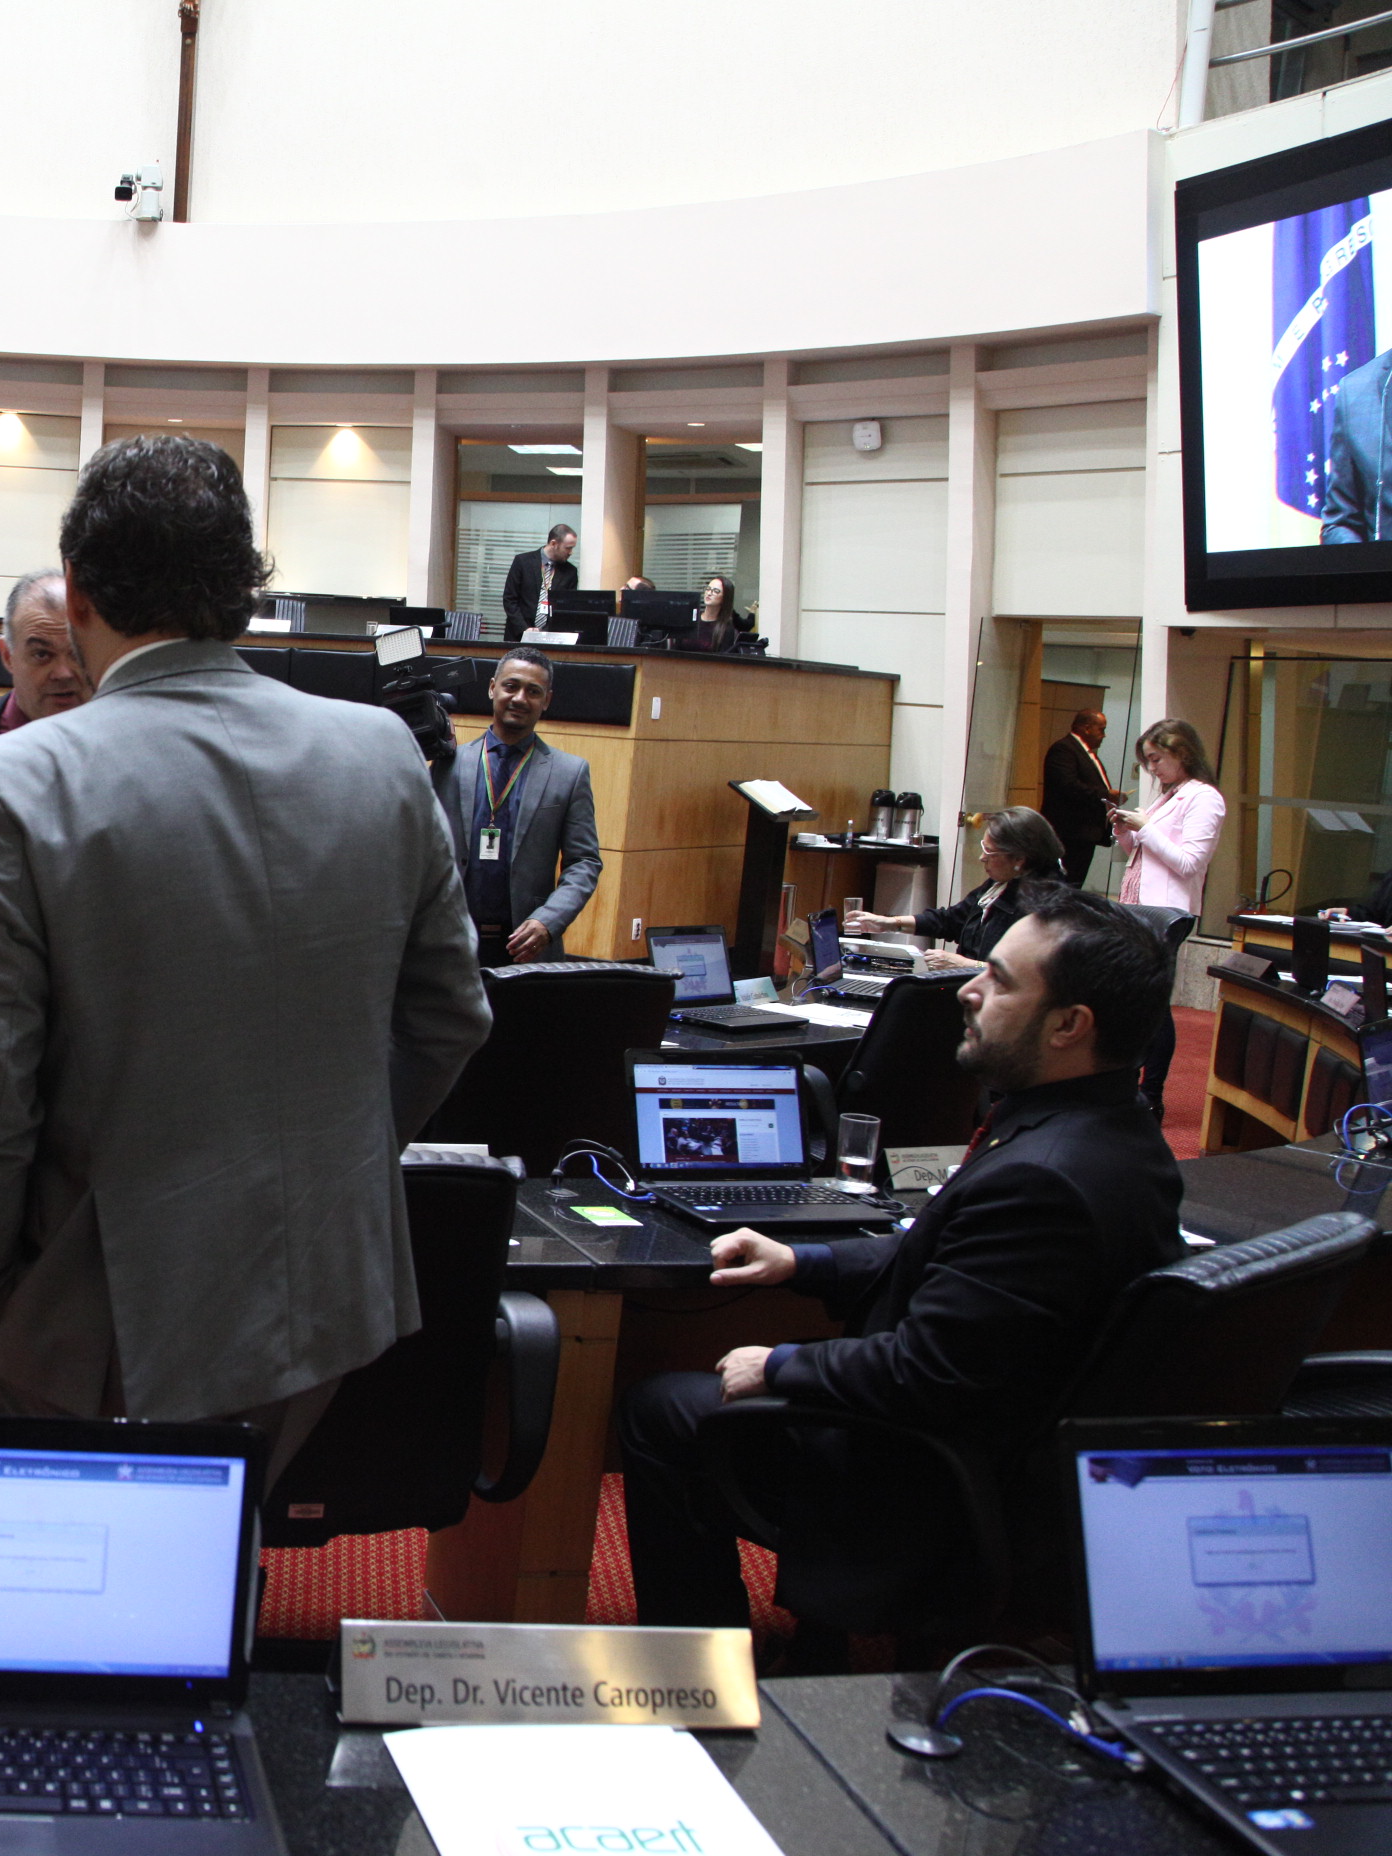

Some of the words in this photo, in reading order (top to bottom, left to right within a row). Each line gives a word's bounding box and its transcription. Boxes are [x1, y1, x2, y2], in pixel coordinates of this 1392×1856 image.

[385, 1676, 442, 1711] Dep.
[453, 1677, 484, 1706] Dr.
[493, 1678, 585, 1708] Vicente
[594, 1681, 718, 1715] Caropreso
